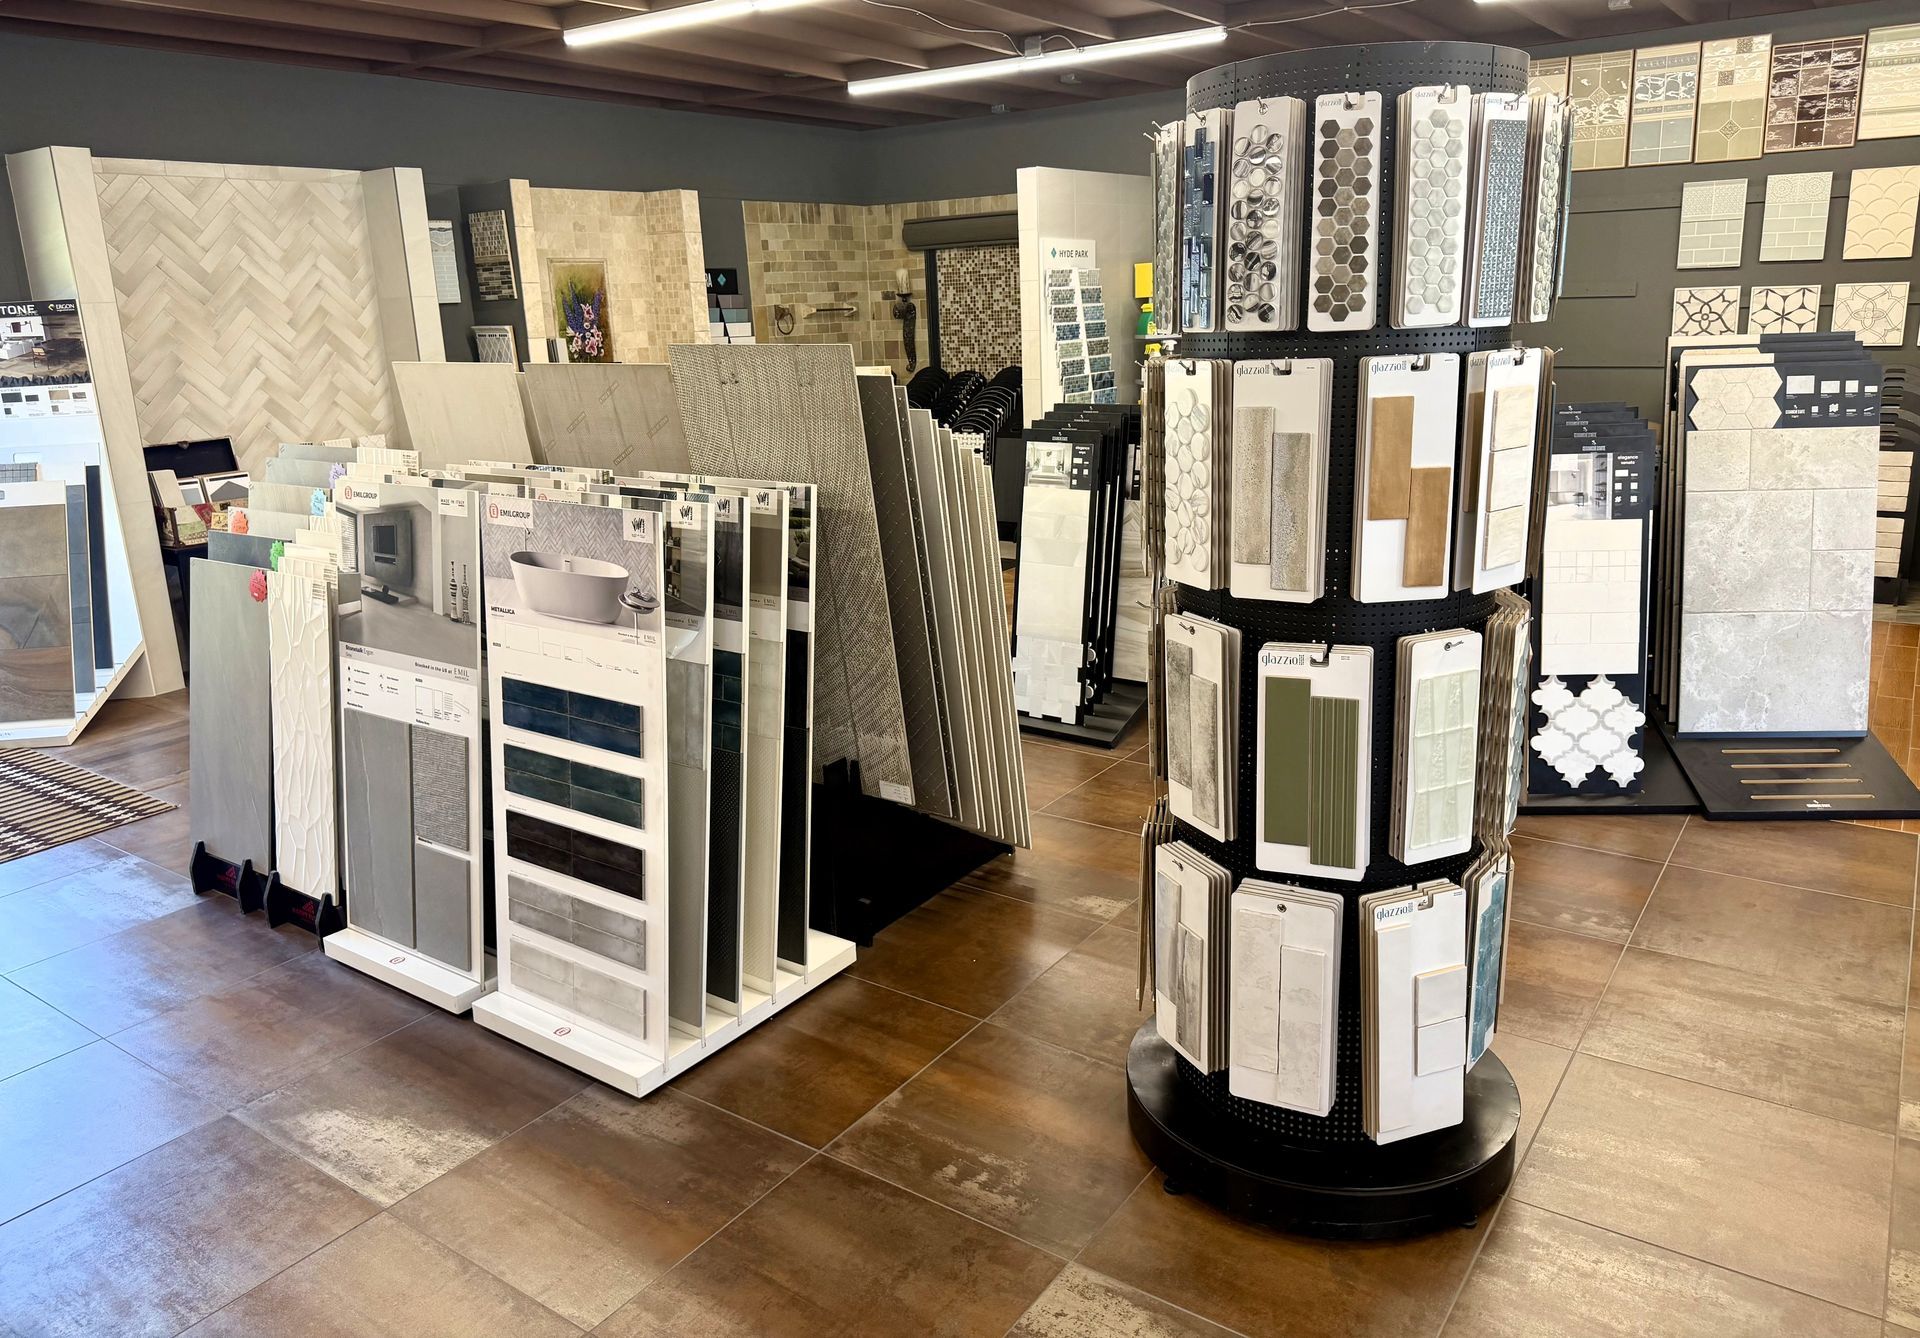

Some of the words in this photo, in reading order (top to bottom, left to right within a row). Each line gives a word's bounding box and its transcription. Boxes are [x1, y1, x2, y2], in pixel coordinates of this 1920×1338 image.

[1059, 249, 1074, 258] HYDE
[1075, 249, 1089, 258] PARK
[1236, 364, 1265, 377] glazzio
[1371, 361, 1402, 375] glazzio
[353, 490, 378, 500] EMILGROUP
[499, 509, 531, 520] EMILGROUP
[490, 605, 516, 615] METALLICA
[1261, 652, 1299, 667] glazzio
[1376, 905, 1408, 921] glazzio
